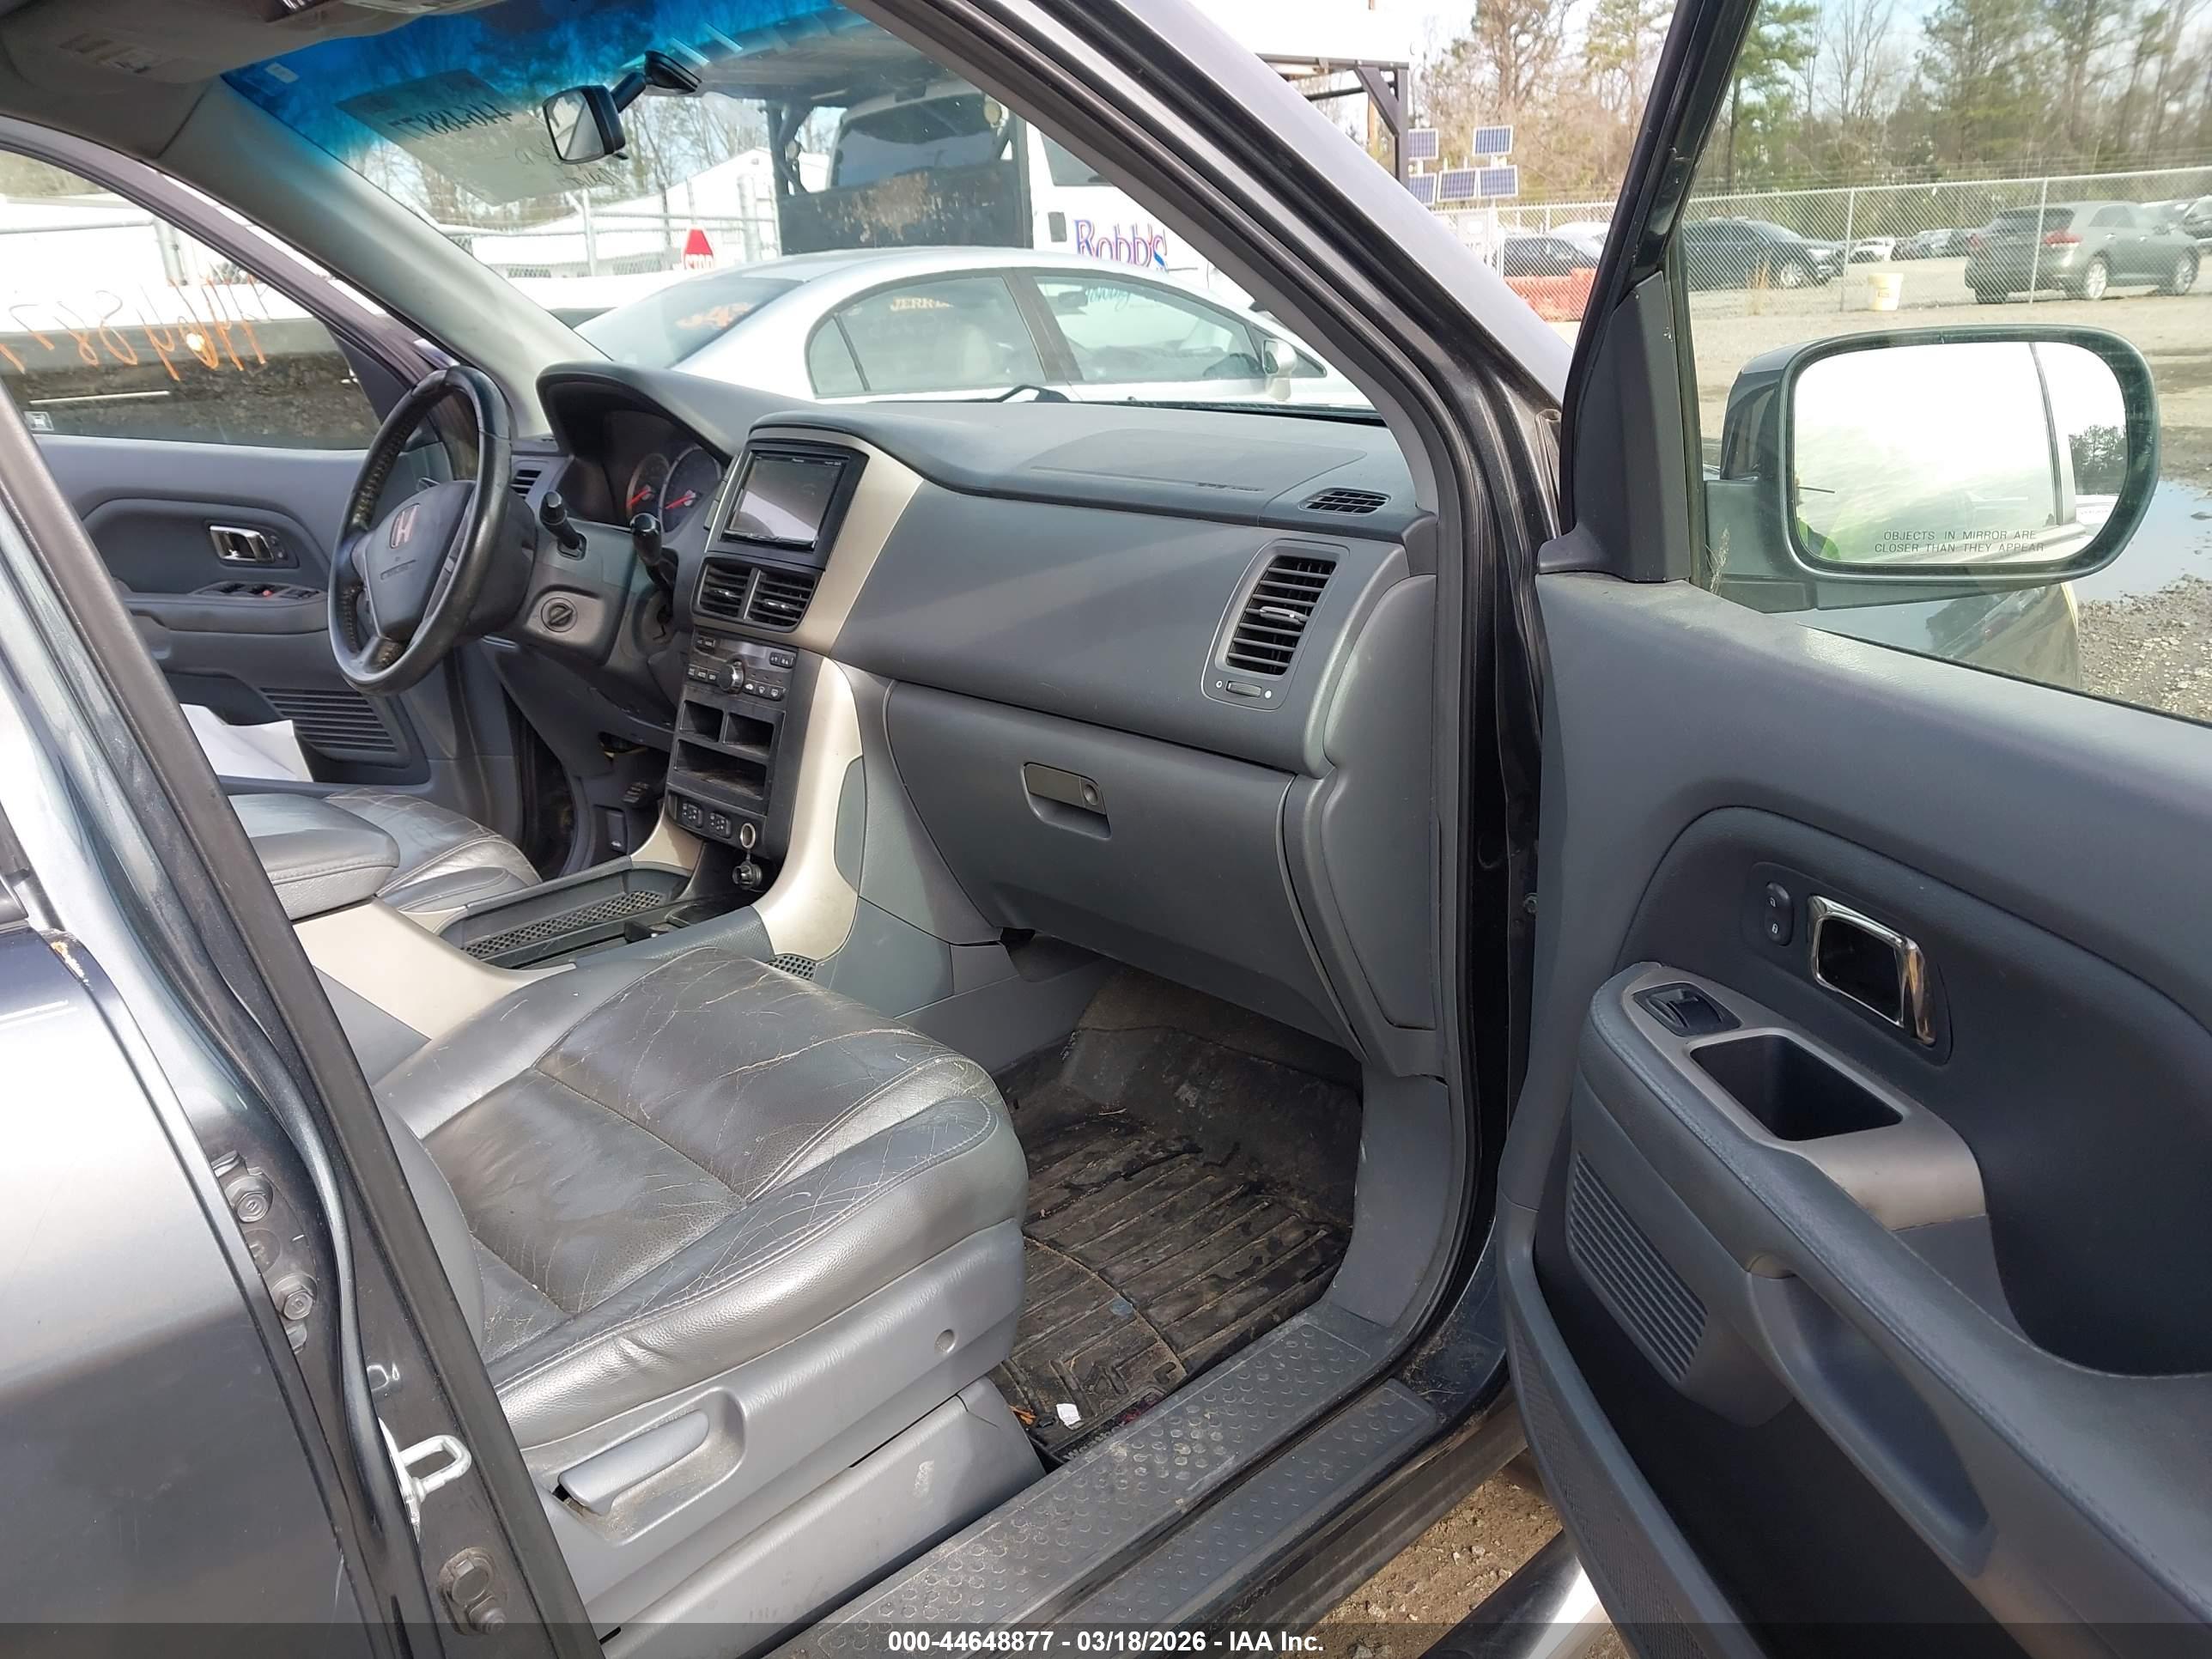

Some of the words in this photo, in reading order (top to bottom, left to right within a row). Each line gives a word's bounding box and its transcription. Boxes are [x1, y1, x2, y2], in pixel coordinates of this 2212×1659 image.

[1883, 530, 1936, 541] OBJECTS
[1944, 530, 1956, 540] IN
[1962, 530, 2008, 541] MIRROR
[2013, 529, 2038, 540] ARE
[1874, 543, 1919, 554] CLOSER
[1925, 543, 1955, 553] THAN
[1963, 543, 1992, 553] THEY
[1998, 542, 2045, 553] APPEAR
